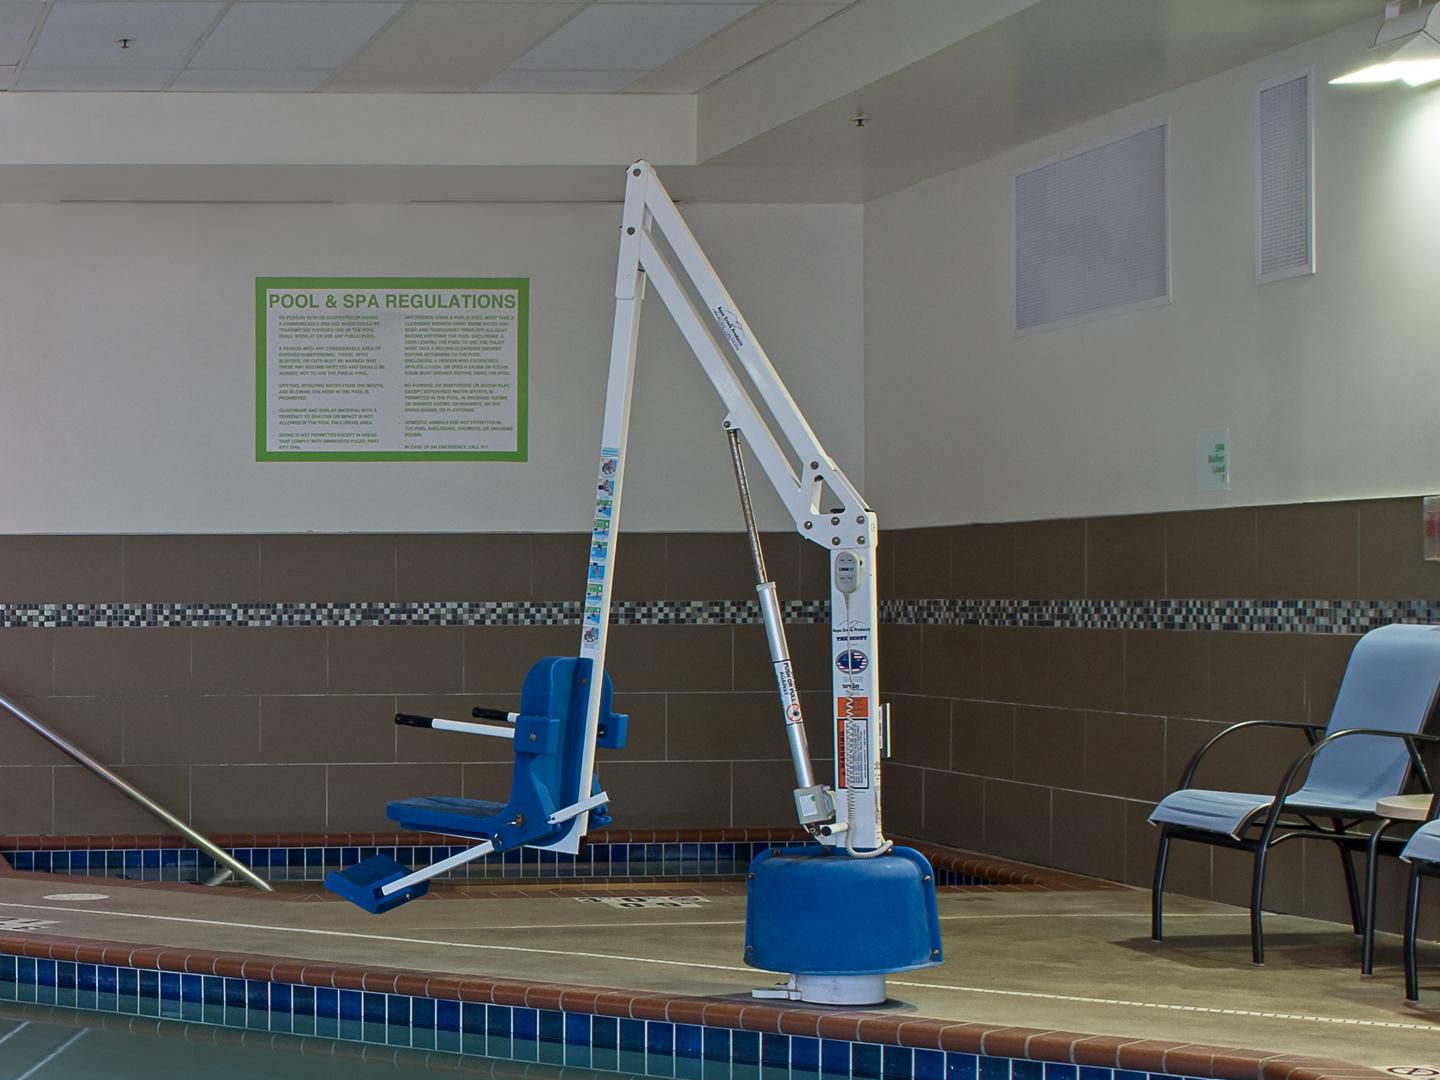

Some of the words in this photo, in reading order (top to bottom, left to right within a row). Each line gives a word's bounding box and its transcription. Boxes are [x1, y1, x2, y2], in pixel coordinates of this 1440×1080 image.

[269, 294, 319, 308] POOL
[325, 294, 337, 308] &
[343, 294, 379, 308] SPA
[385, 294, 516, 309] REGULATIONS
